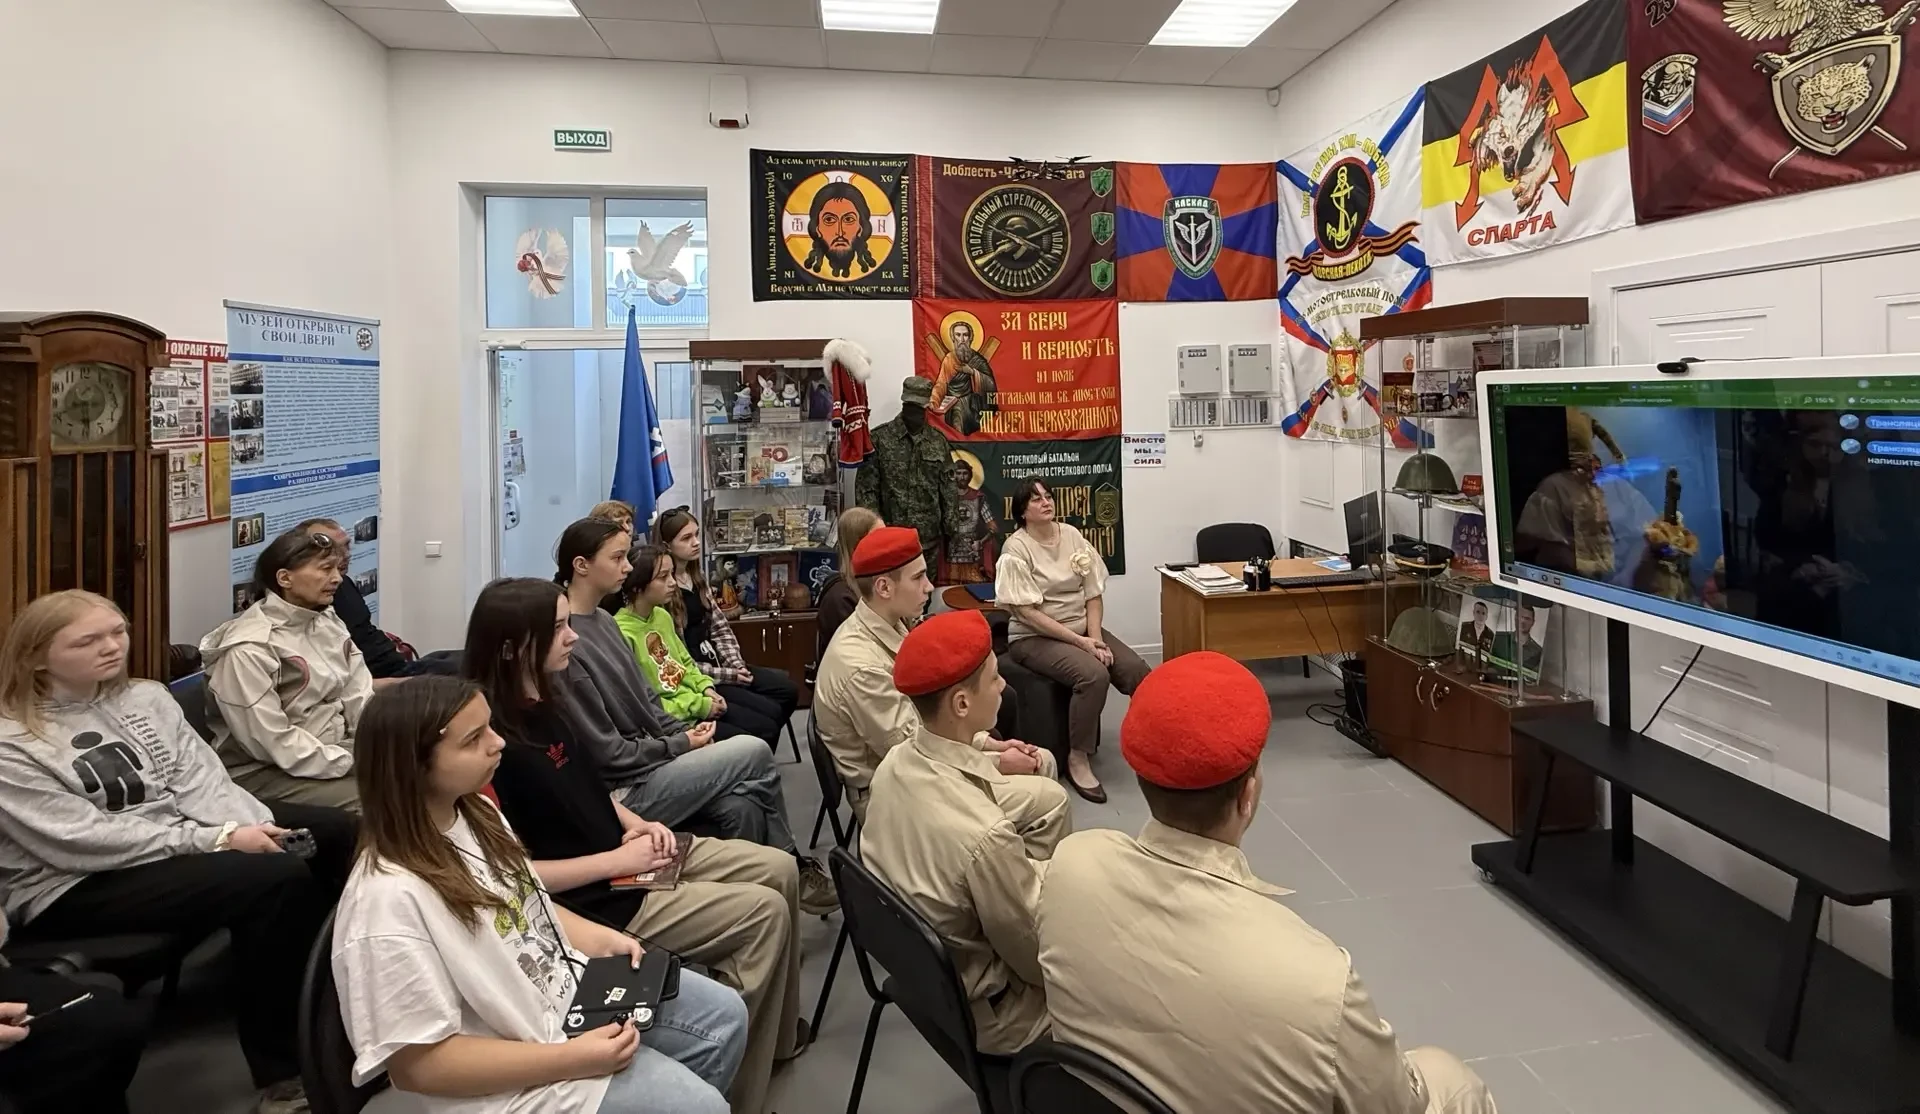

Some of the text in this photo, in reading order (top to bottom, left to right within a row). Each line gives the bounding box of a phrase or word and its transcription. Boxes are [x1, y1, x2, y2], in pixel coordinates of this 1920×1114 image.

[557, 132, 606, 146] ВЫХОД
[766, 155, 780, 164] Аз
[805, 159, 828, 167] путь
[1174, 198, 1209, 208] КАСКАД
[970, 195, 1002, 244] ОТДЕЛЬНЫЙ
[1002, 193, 1058, 224] СТРЕЛКОВЫЙ
[1051, 231, 1063, 255] ПОЛК
[1467, 211, 1557, 246] СПАРТА
[238, 312, 352, 335] МУЗЕЙ ОТКРЫВАЕТ
[1001, 311, 1068, 331] ЗА ВЕРУ
[261, 330, 335, 346] СВОИ ДВЕРИ
[171, 342, 208, 357] ОХРАНЕ
[1022, 338, 1115, 360] И ВЕРНОСТЬ
[1051, 370, 1075, 382] ПОЛК
[986, 391, 1036, 405] БАТАЛЬОН
[1072, 387, 1116, 402] АПОСТОЛА
[979, 405, 1119, 437] АНДРЕЯ ПЕРВОЗВАННОГО
[1124, 436, 1166, 444] Вместе
[1002, 452, 1080, 465] 2 СТРЕЛКОВЫЙ БАТАЛЬОН
[1133, 457, 1162, 465] сила
[1010, 467, 1049, 479] ОТДЕЛЬНОГО
[1050, 464, 1092, 477] СТРЕЛКОВОГО
[1092, 463, 1113, 474] ПОЛКА
